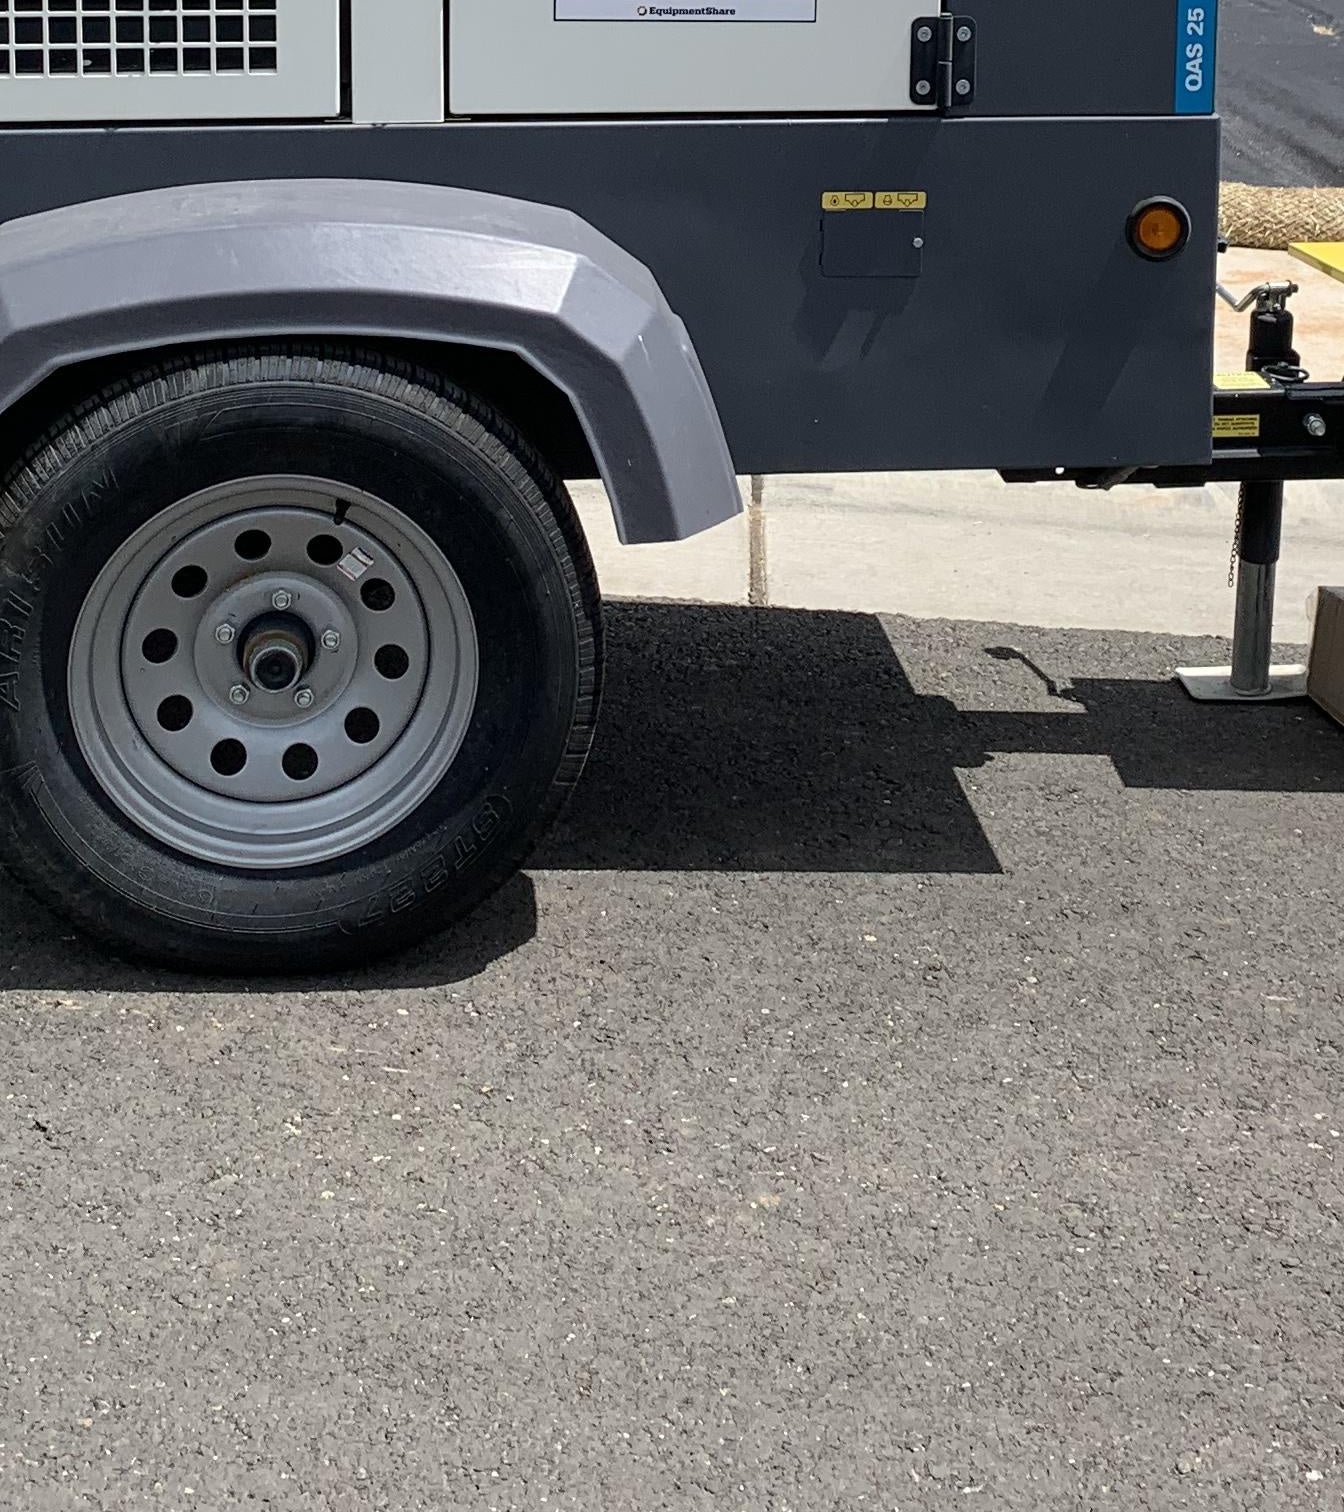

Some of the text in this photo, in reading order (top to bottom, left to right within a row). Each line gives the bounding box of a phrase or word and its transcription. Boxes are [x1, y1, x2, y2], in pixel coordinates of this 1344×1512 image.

[648, 6, 736, 16] EquipmentShare
[1184, 7, 1205, 92] QAS 25
